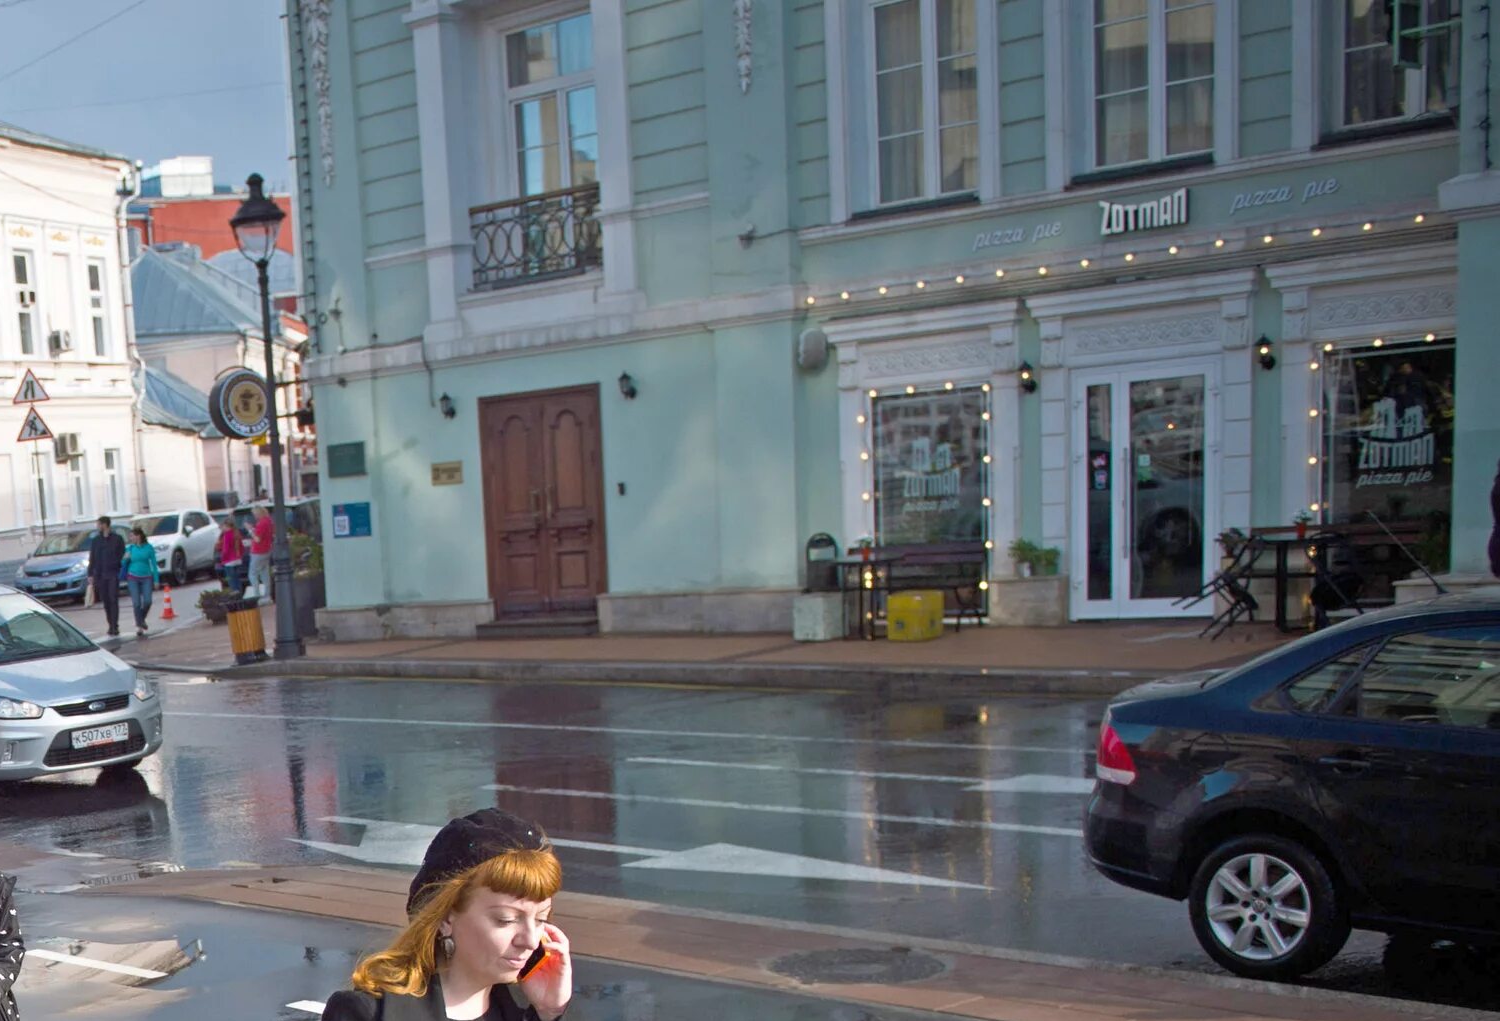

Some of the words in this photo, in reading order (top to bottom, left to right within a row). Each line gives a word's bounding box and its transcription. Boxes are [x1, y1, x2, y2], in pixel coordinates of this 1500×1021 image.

[1099, 188, 1188, 236] ZOTMAN
[1229, 186, 1292, 214] pizza
[1300, 176, 1341, 203] pie
[972, 230, 1026, 250] pizza
[1032, 221, 1063, 242] pie
[1358, 432, 1434, 469] ZOTMAN
[1356, 471, 1403, 488] pizza
[1404, 468, 1434, 486] pie
